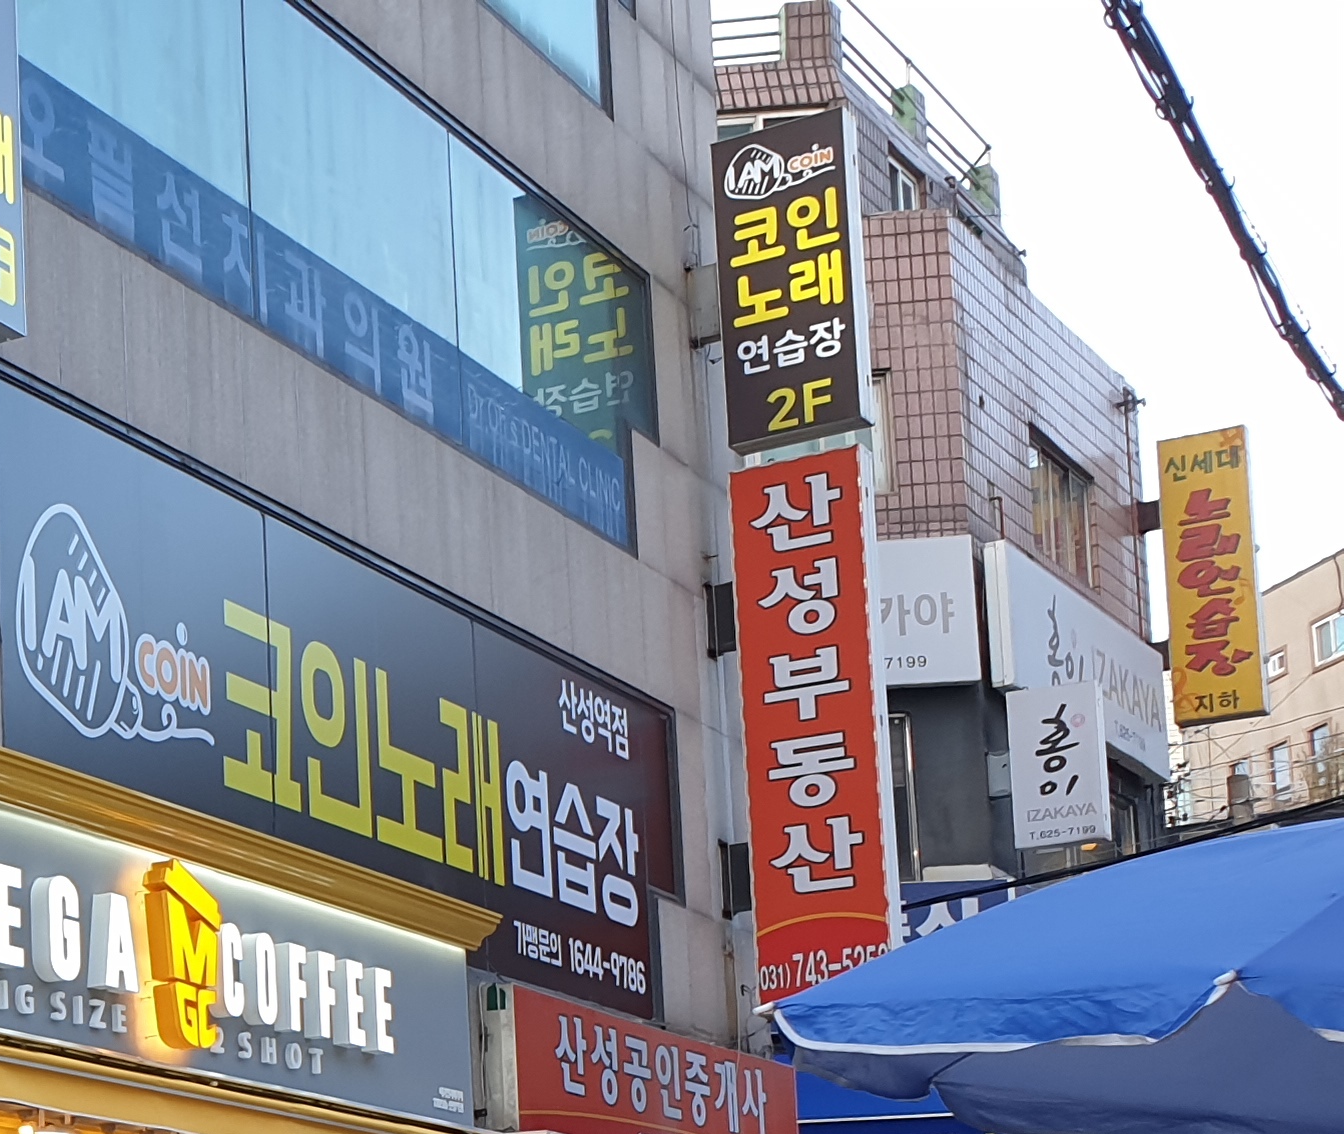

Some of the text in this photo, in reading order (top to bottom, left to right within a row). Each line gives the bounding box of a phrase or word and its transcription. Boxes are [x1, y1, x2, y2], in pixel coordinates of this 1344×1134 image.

[730, 187, 841, 268] 코인
[733, 249, 845, 329] 노래
[737, 317, 845, 376] 연습장
[766, 377, 832, 432] 2F
[579, 456, 621, 512] CLINIC
[1164, 446, 1240, 482] 신세대
[558, 678, 630, 760] 산성역점
[749, 471, 865, 895] 산성부동산
[1194, 689, 1240, 713] 지하
[1026, 802, 1098, 823] IZAKAYA
[219, 922, 396, 1055] COFFEE
[513, 919, 646, 995] 가맹문의 1644-9786
[49, 990, 128, 1034] SIZE
[237, 1030, 324, 1075] SHOT
